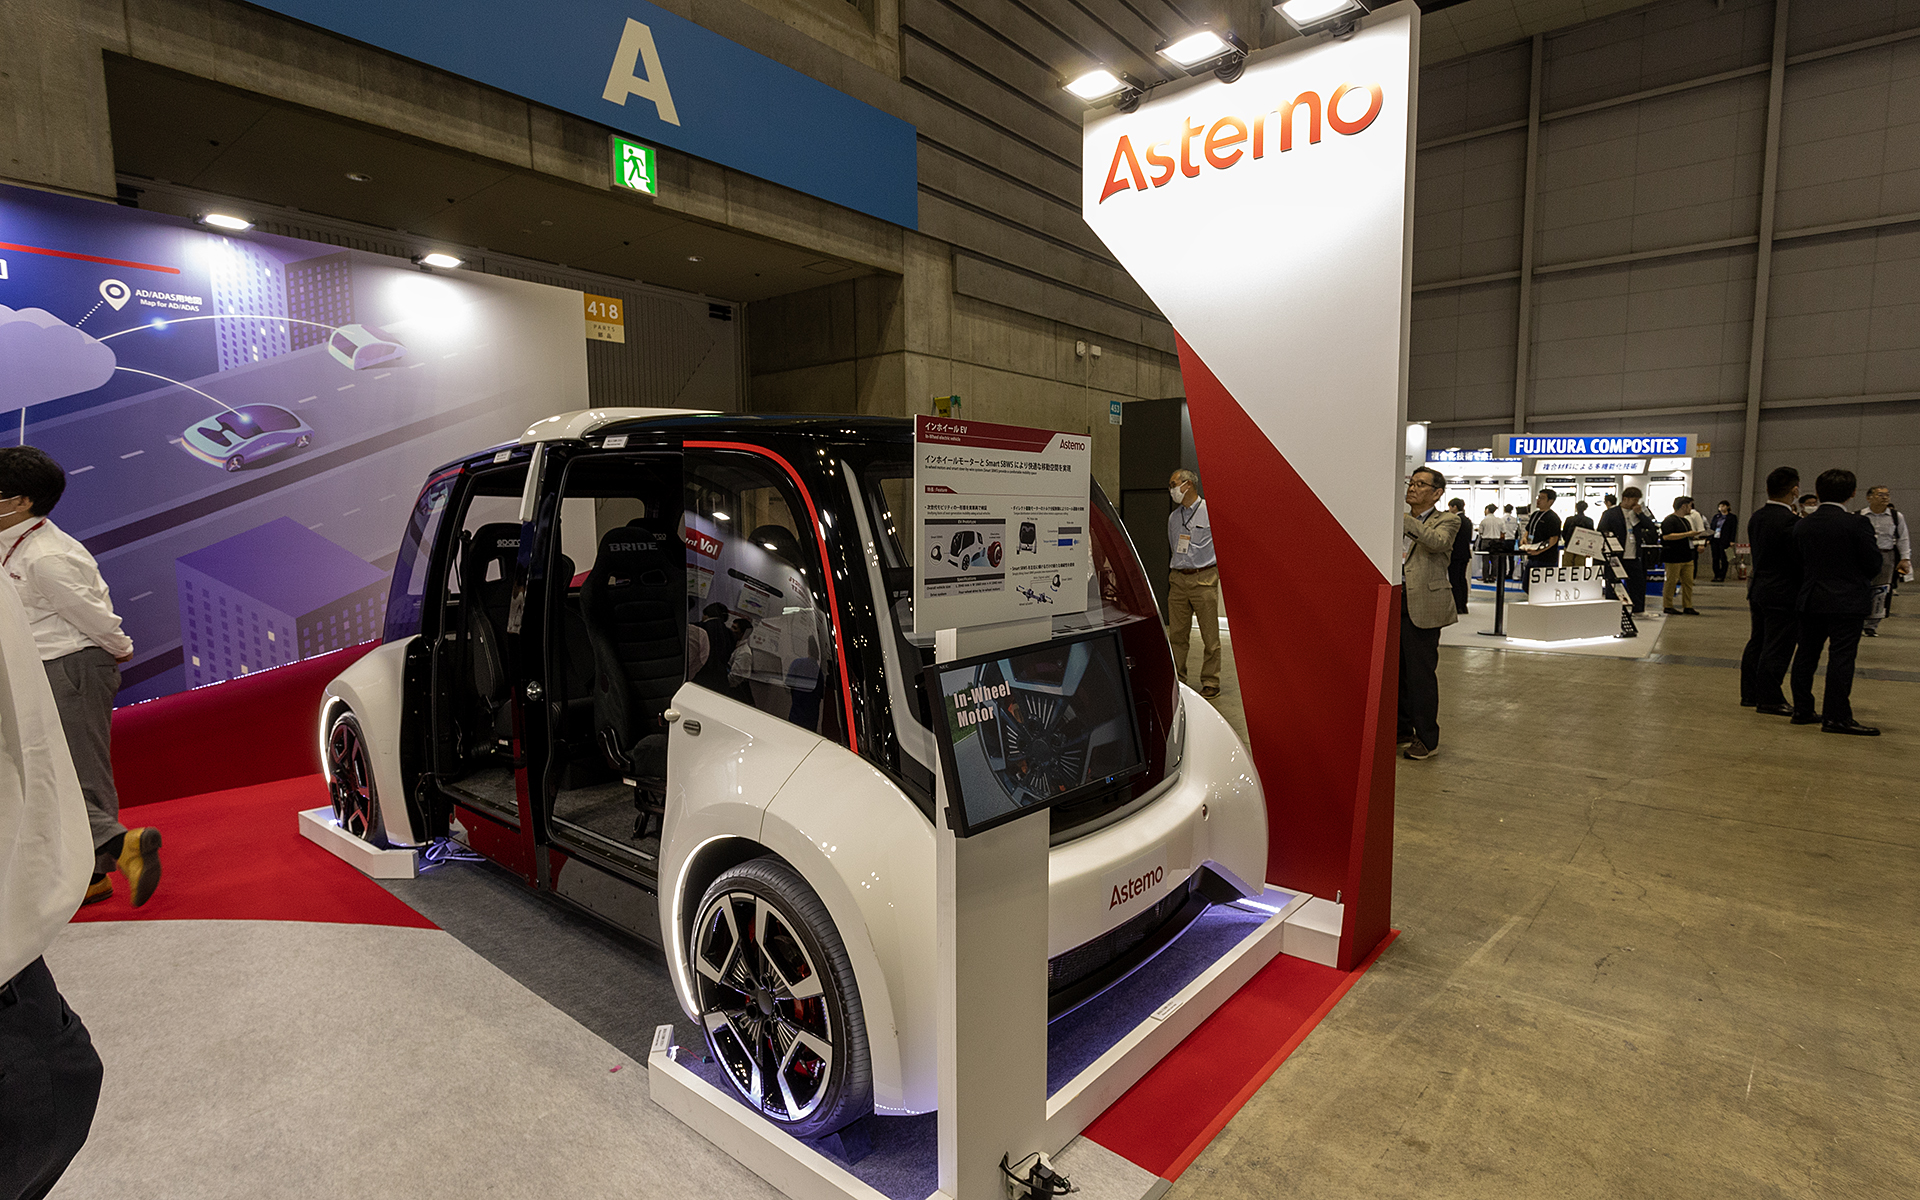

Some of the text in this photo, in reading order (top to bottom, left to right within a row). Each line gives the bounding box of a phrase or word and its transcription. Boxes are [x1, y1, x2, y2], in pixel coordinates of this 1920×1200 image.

[602, 17, 681, 127] A
[1099, 81, 1384, 205] Astemo
[140, 299, 200, 312] Map for AD/ADAS
[587, 301, 619, 320] 418
[593, 324, 616, 332] PARTS
[925, 422, 968, 435] インホイール EV
[1059, 439, 1086, 452] Astemo
[1515, 438, 1679, 454] FUJIKURA COMPOSITES
[985, 459, 1000, 467] Smart
[608, 542, 658, 551] BRIDE
[1531, 566, 1605, 583] SPEEDA
[953, 680, 1011, 709] In-Wheel
[957, 705, 995, 728] Motor
[1109, 865, 1164, 911] Astemo
